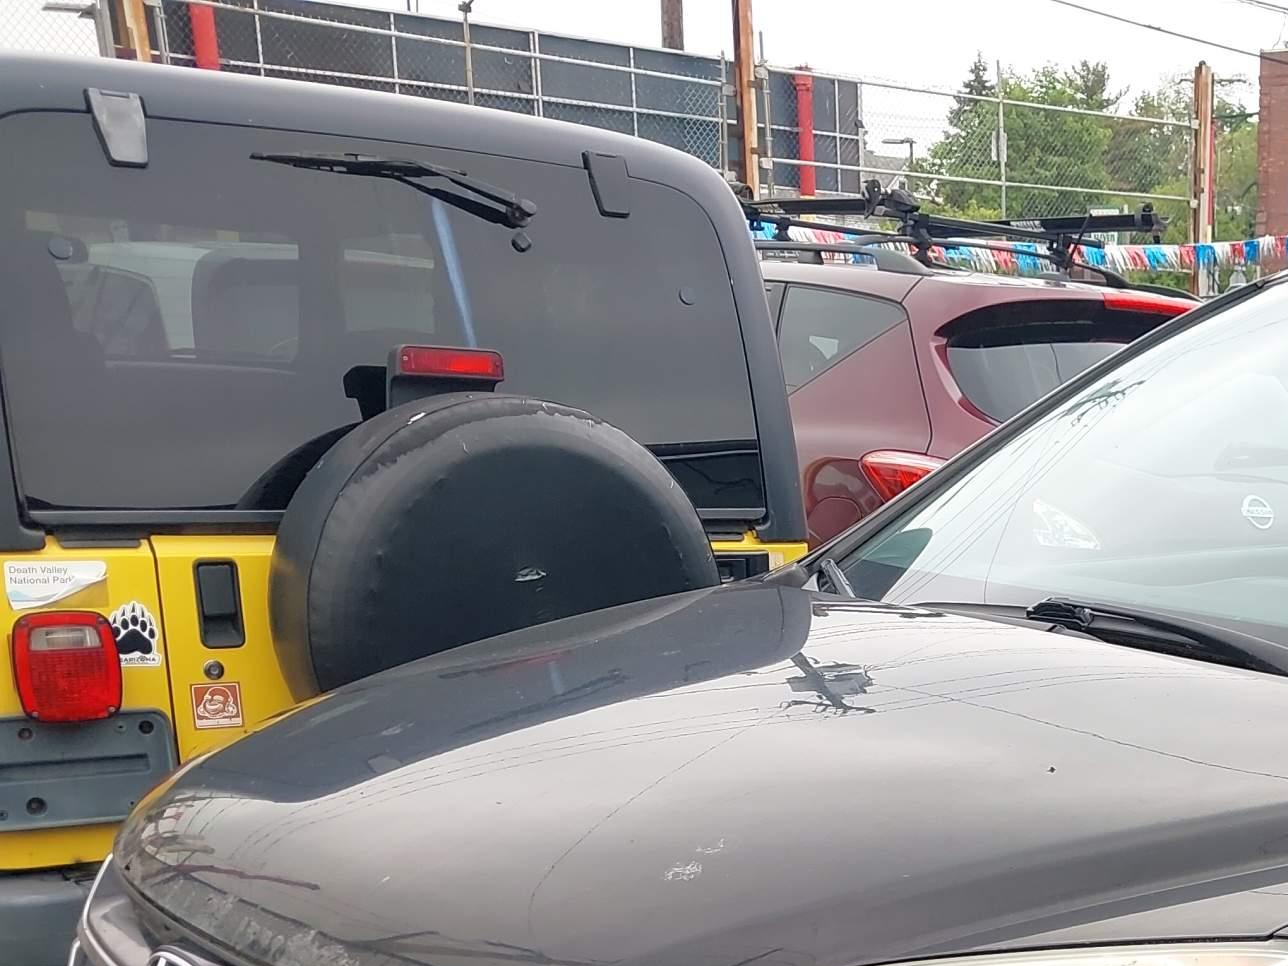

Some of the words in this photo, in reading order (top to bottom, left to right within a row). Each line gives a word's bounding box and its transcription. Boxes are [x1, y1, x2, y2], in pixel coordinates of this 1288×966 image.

[8, 565, 38, 574] Death
[40, 565, 68, 575] Valley
[9, 576, 50, 585] National
